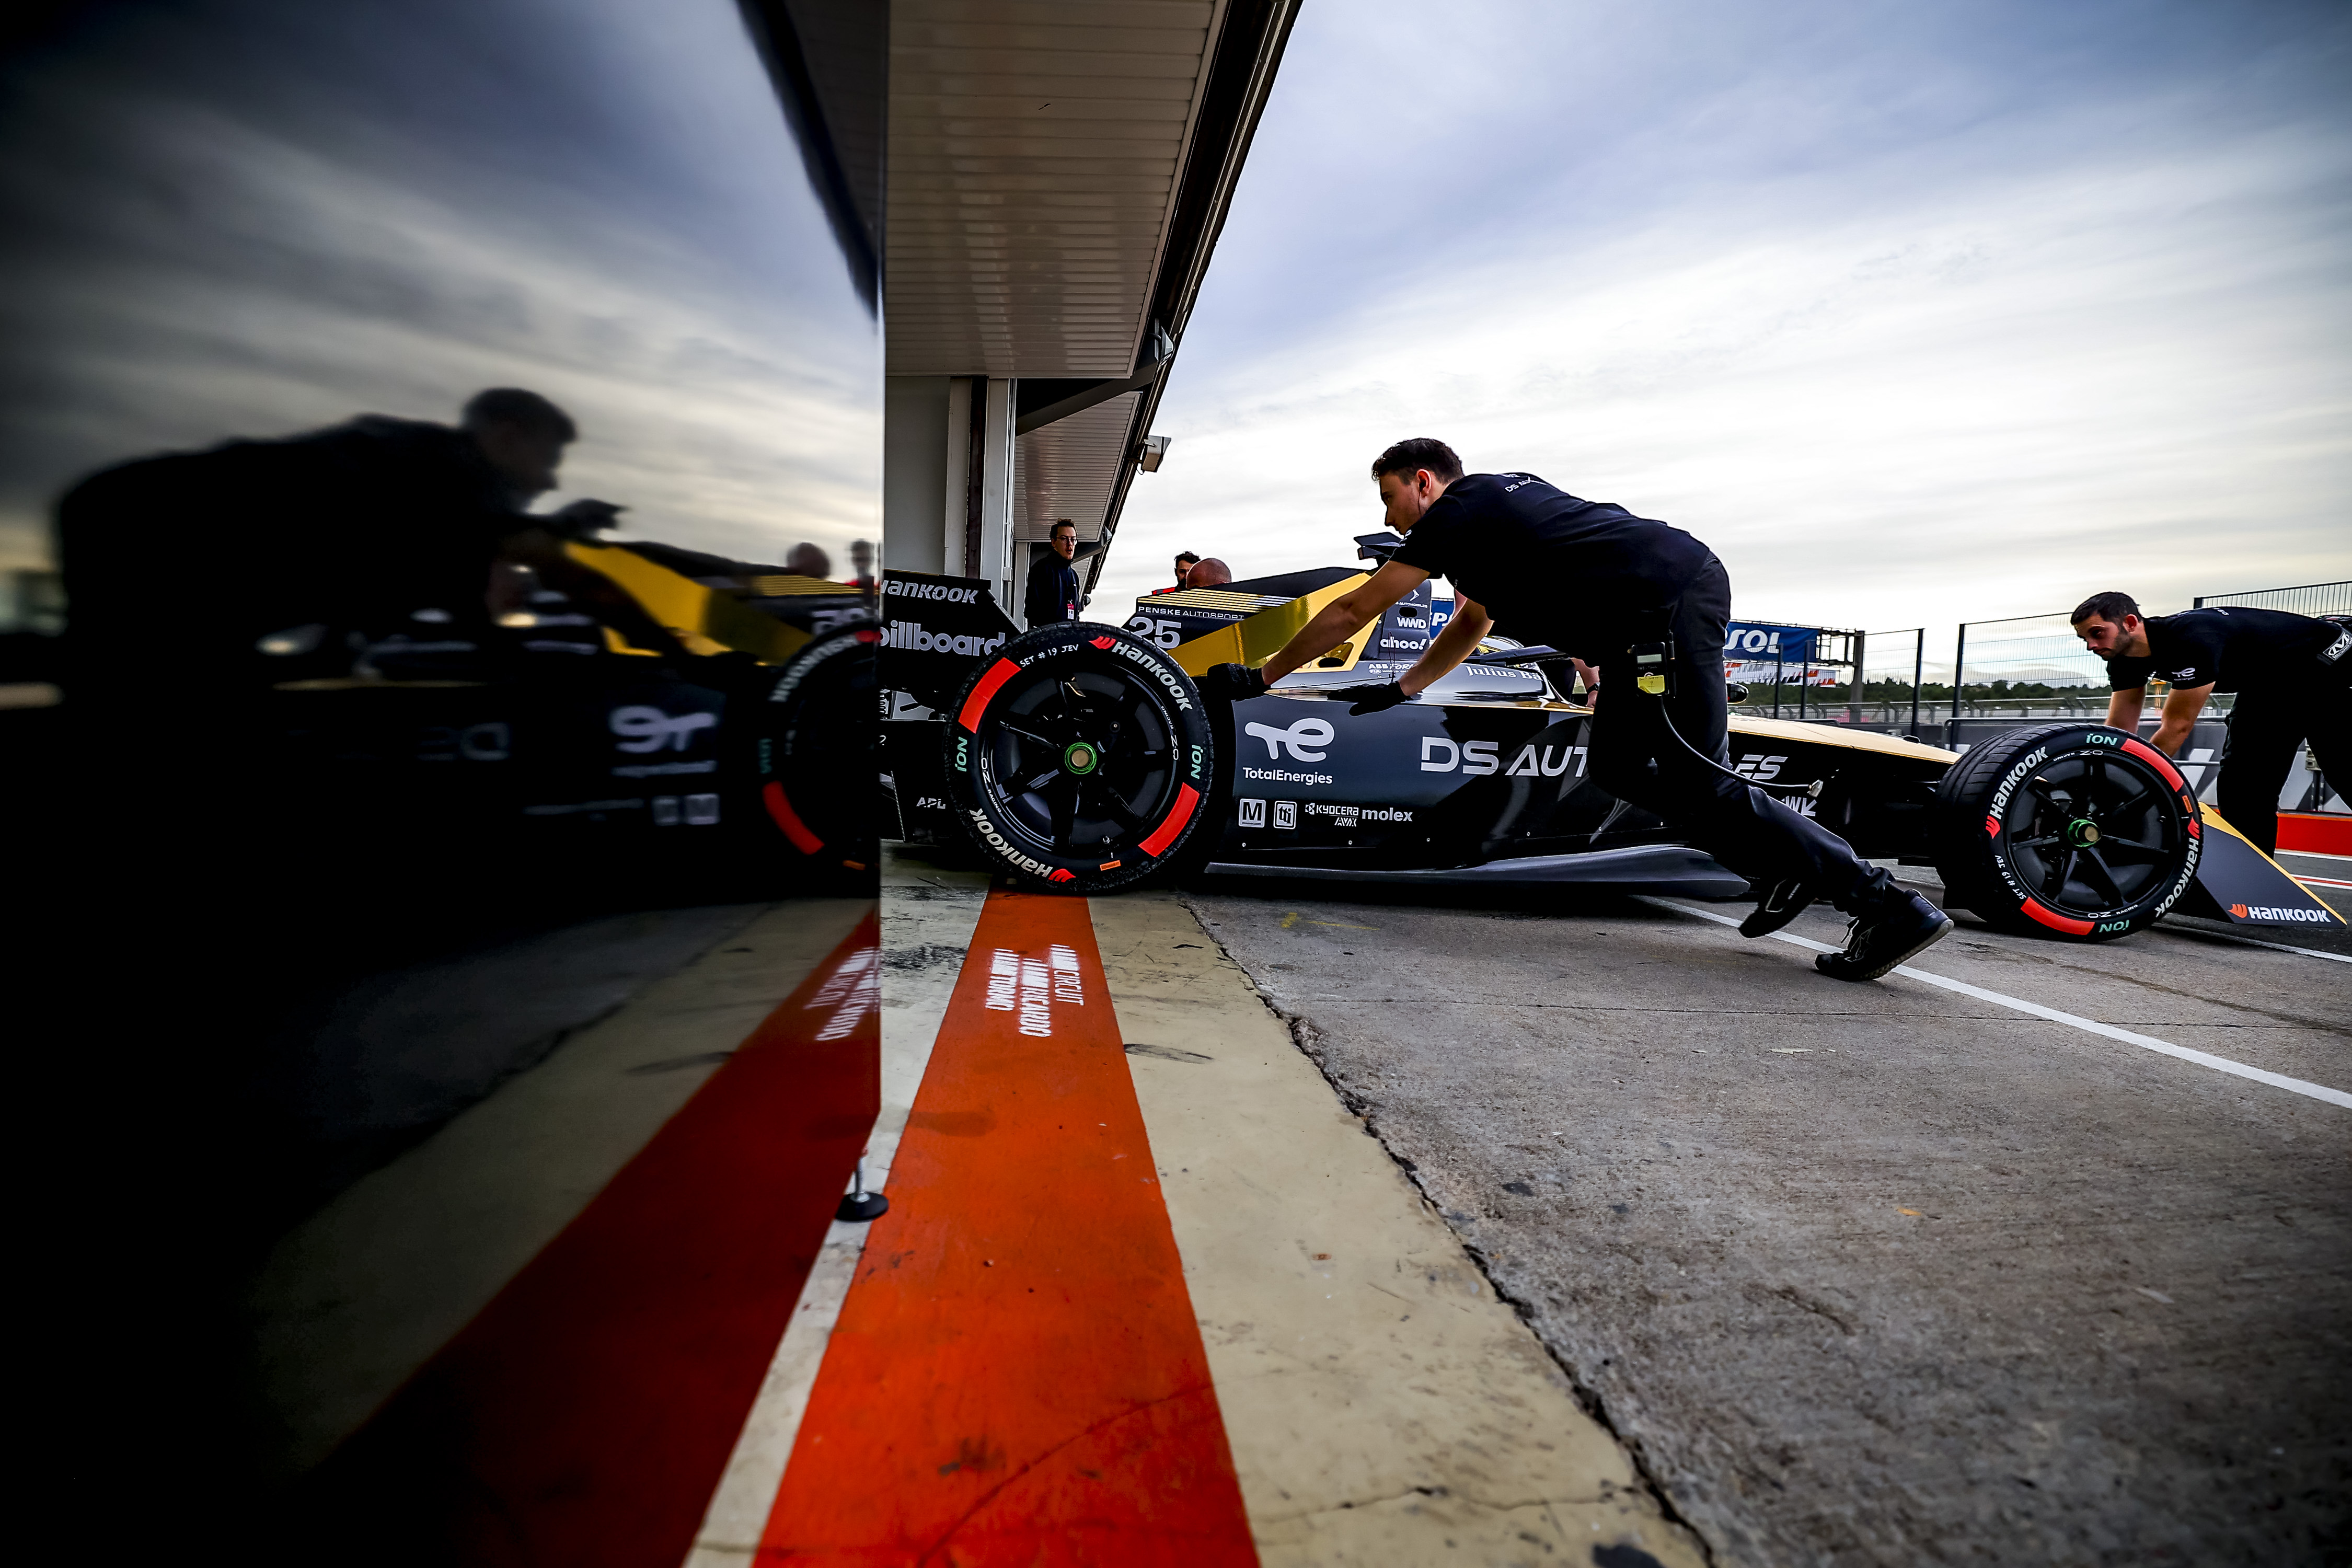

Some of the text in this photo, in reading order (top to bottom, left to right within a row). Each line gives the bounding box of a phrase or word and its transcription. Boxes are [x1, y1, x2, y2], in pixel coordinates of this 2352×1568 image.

[1138, 606, 1244, 619] PENSKE AUTOSPORT
[1397, 617, 1427, 629] WWD
[1129, 616, 1182, 649] 25
[1380, 636, 1427, 650] ahoo!
[1723, 629, 1780, 654] SOL
[1020, 655, 1034, 667] SET
[1047, 648, 1057, 656] 19
[1061, 644, 1079, 653] JEV
[1466, 665, 1517, 678] Julius
[1161, 706, 1174, 729] RACING
[1421, 736, 1588, 777] DS AUT
[1242, 767, 1333, 786] TotalEnergies
[987, 789, 1001, 813] RACING
[1781, 795, 1818, 817] WK
[1316, 804, 1359, 816] KYOCERA
[1362, 807, 1413, 822] molex
[1994, 855, 2005, 869] JEV
[2012, 889, 2027, 900] SET
[2116, 904, 2138, 915] RACING
[2247, 906, 2331, 923] Hankook
[1054, 970, 1085, 1006] CIRCUIT
